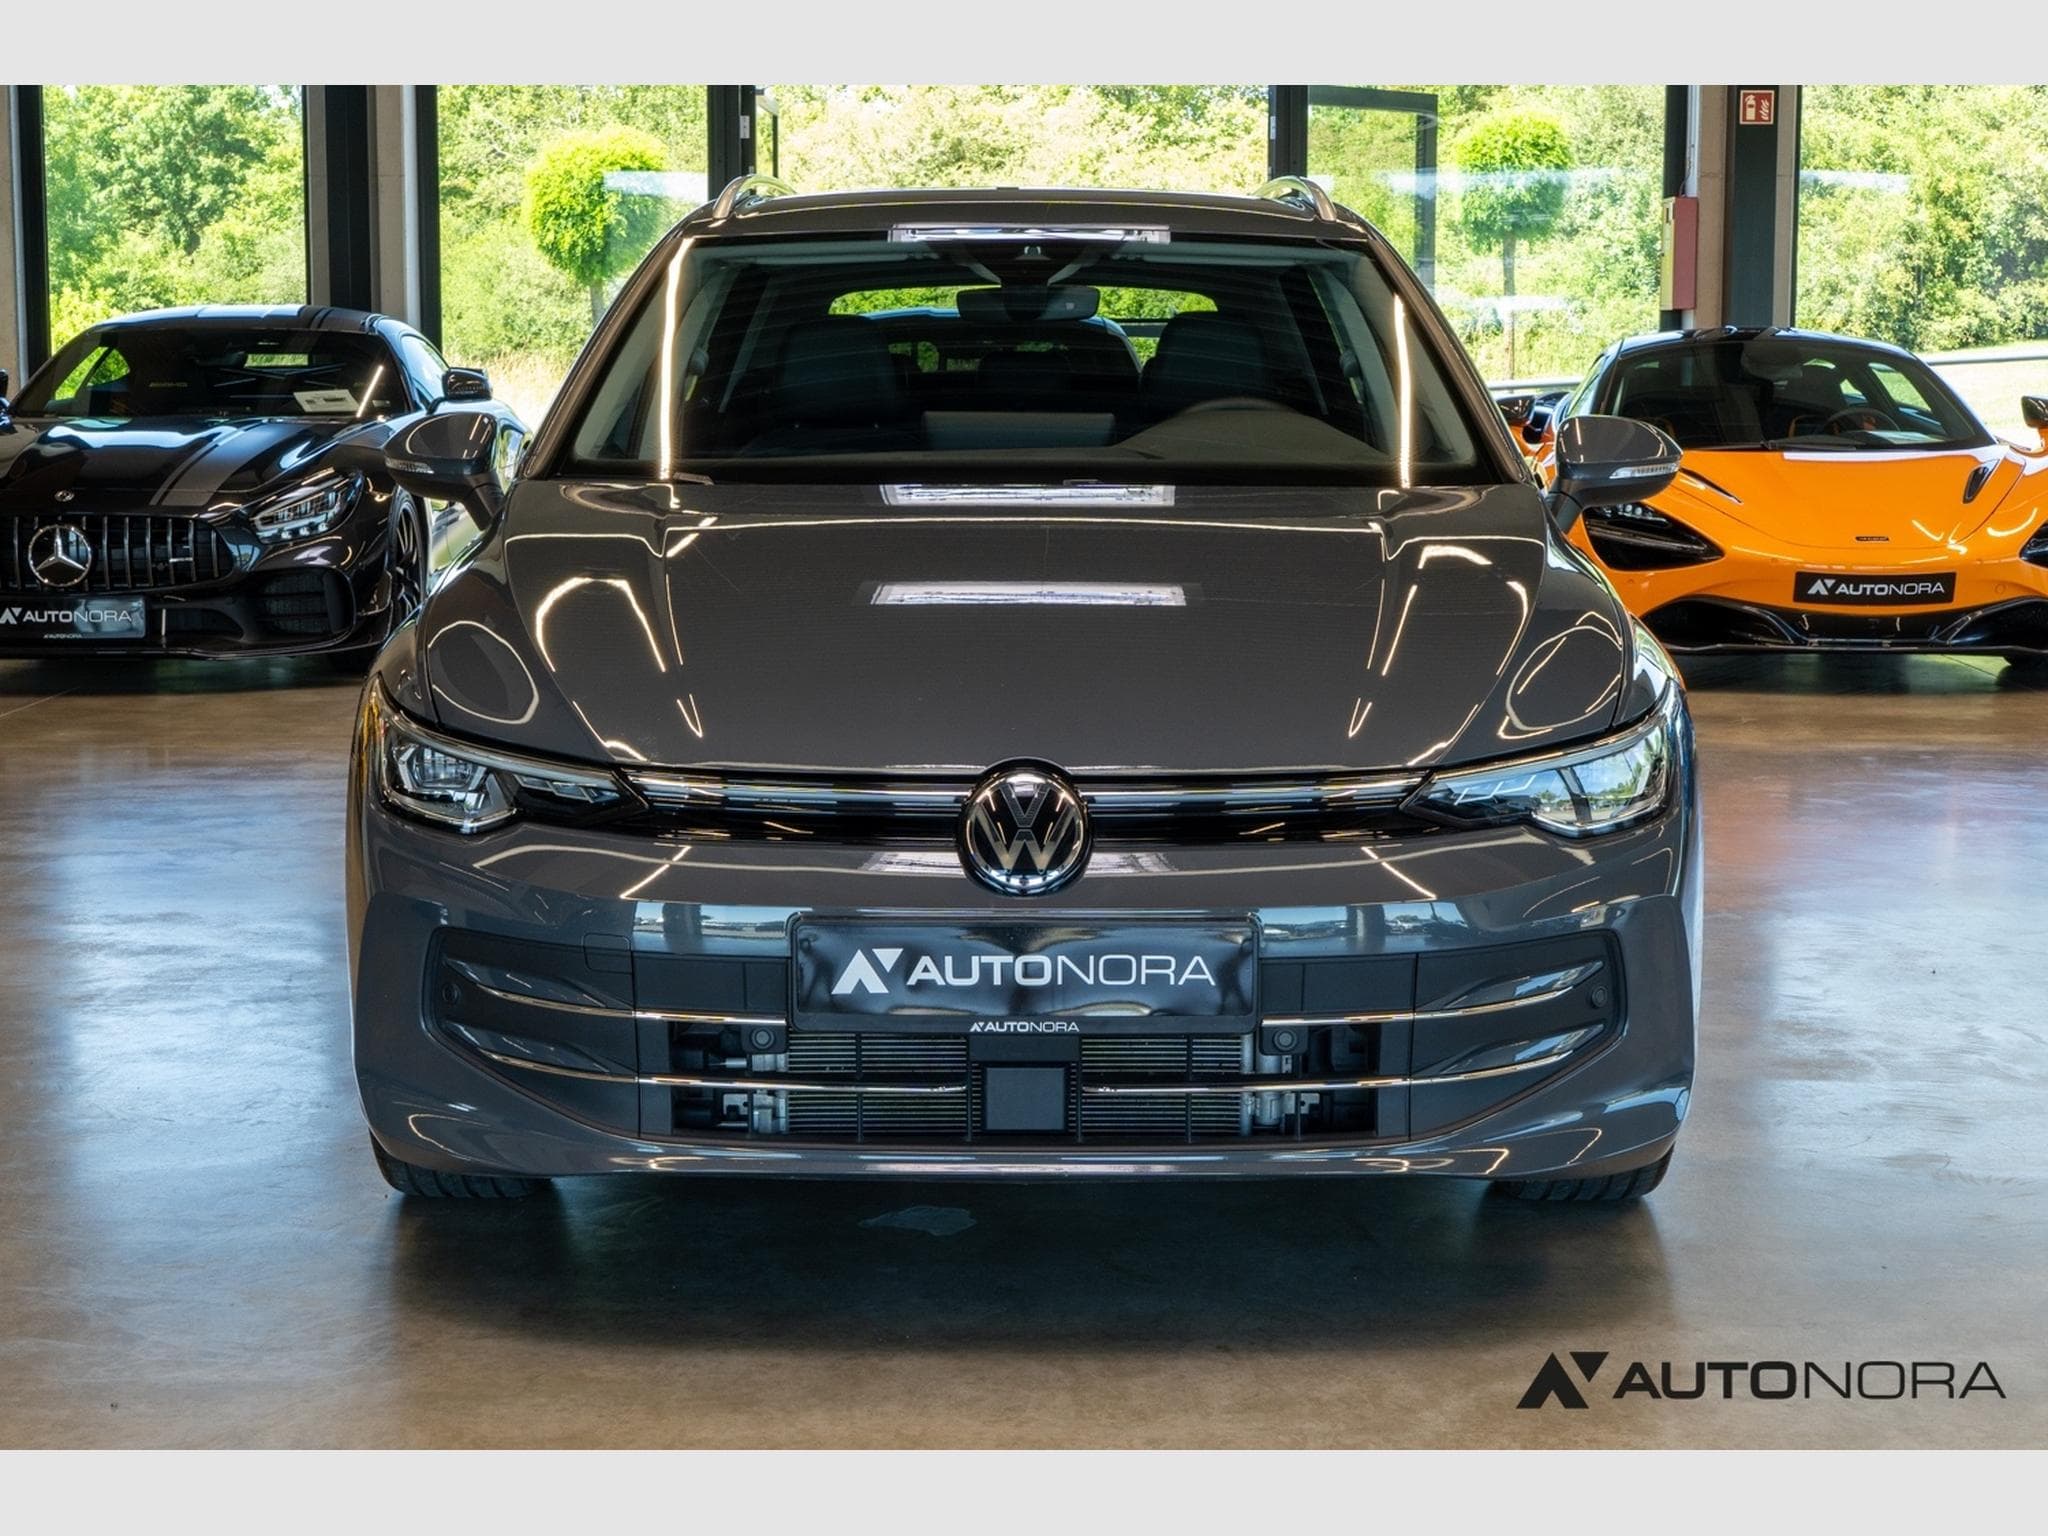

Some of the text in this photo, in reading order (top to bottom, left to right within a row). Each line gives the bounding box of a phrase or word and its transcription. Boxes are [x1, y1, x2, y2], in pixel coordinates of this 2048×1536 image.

[1834, 582, 1946, 596] AUTONORA
[22, 610, 132, 622] AUTONORA
[906, 955, 1216, 986] AUTONORA
[984, 1021, 1080, 1032] AUTONORA
